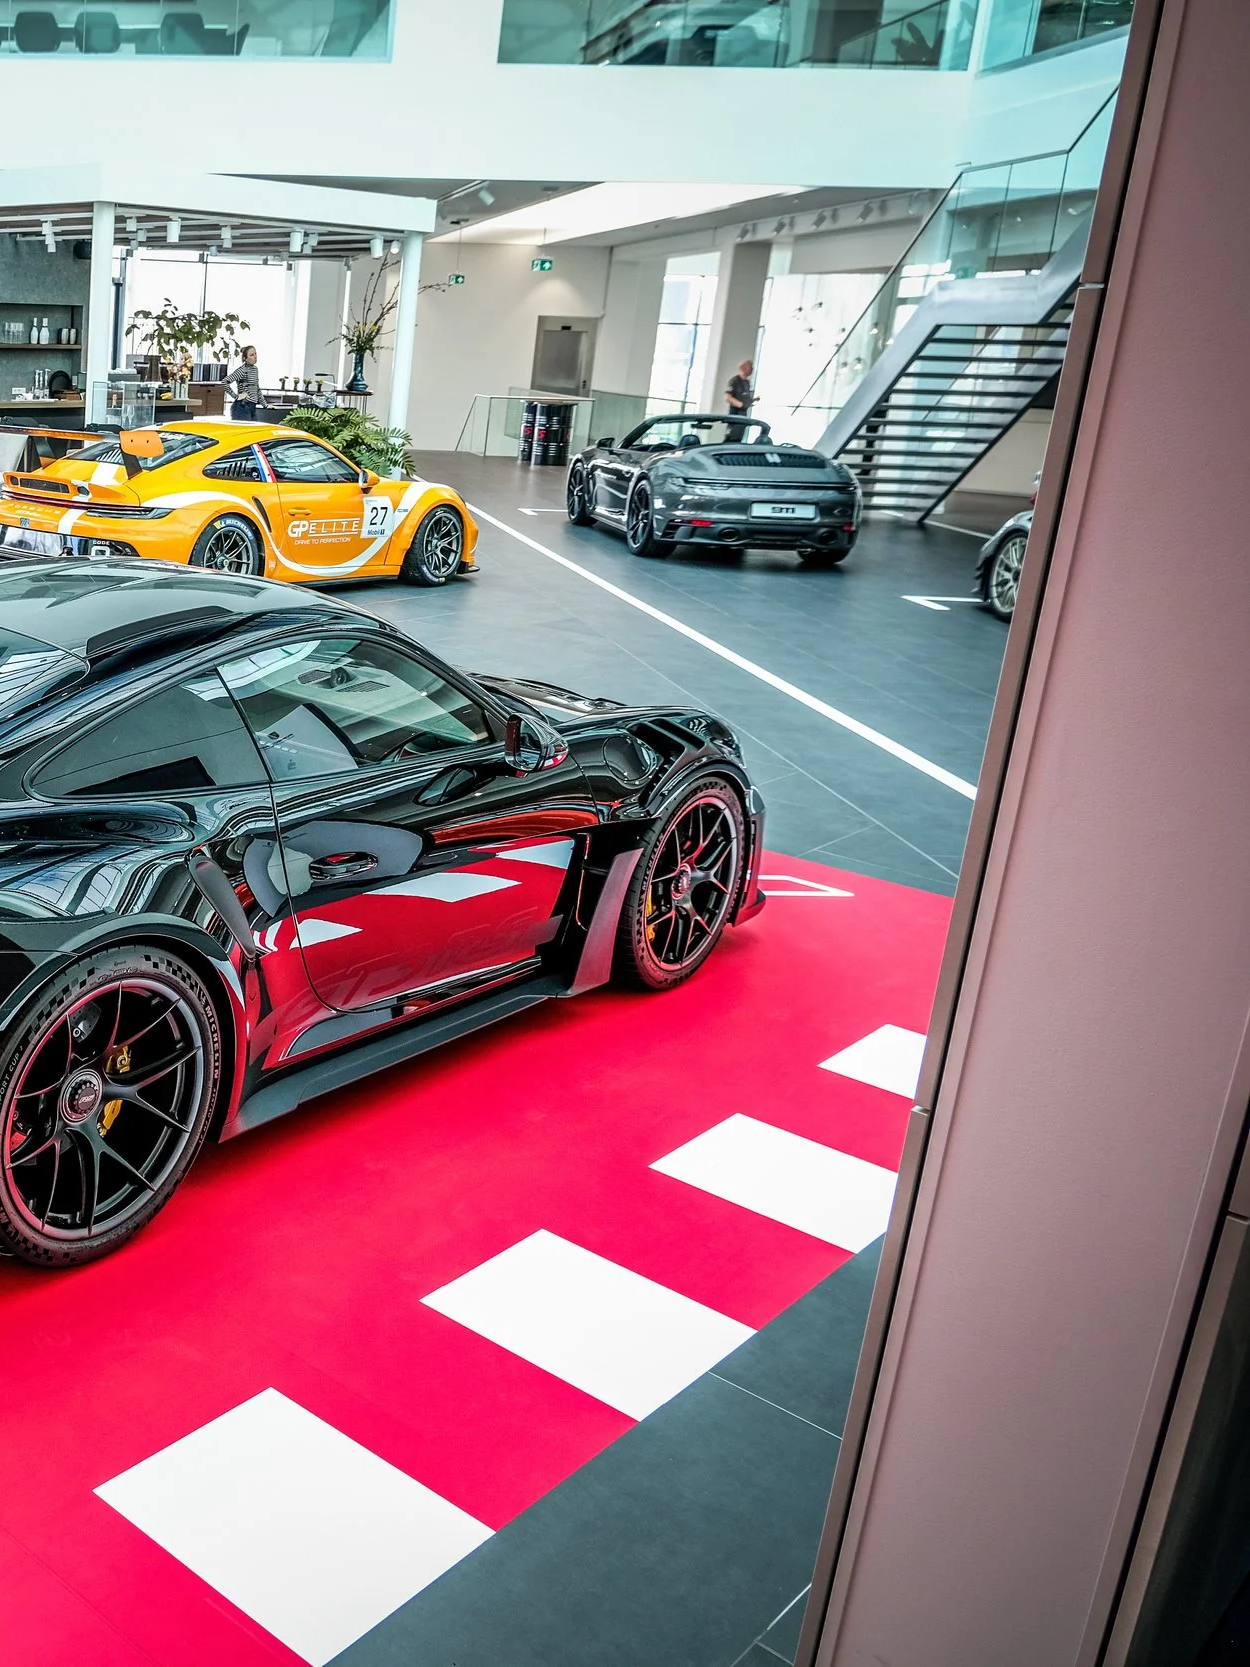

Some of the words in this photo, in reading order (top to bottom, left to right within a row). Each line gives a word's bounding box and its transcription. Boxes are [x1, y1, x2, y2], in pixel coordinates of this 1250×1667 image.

[8, 503, 62, 516] PORSCHE
[369, 506, 389, 526] 27
[226, 518, 254, 541] MICHELIN
[309, 519, 361, 535] ELITE
[294, 538, 311, 546] DRIVE
[319, 536, 352, 545] PERFECTION
[205, 1006, 220, 1080] MICHELIN
[9, 1052, 20, 1073] CUP
